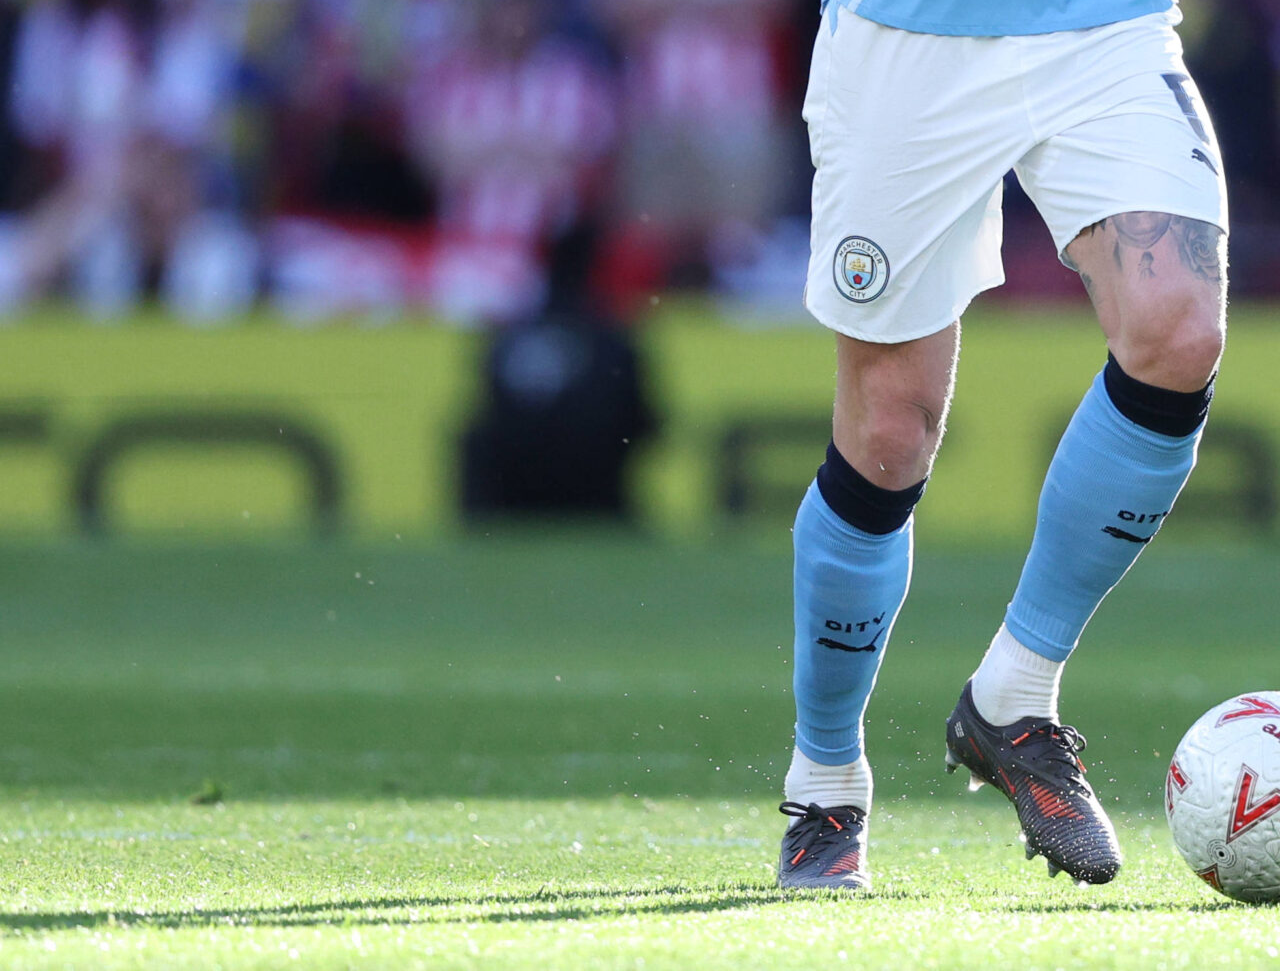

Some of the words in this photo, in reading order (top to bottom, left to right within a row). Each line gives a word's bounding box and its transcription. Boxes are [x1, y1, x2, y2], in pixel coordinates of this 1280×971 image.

[840, 241, 883, 264] MANCHESTER
[849, 290, 866, 298] CITY
[1117, 509, 1168, 524] CIT
